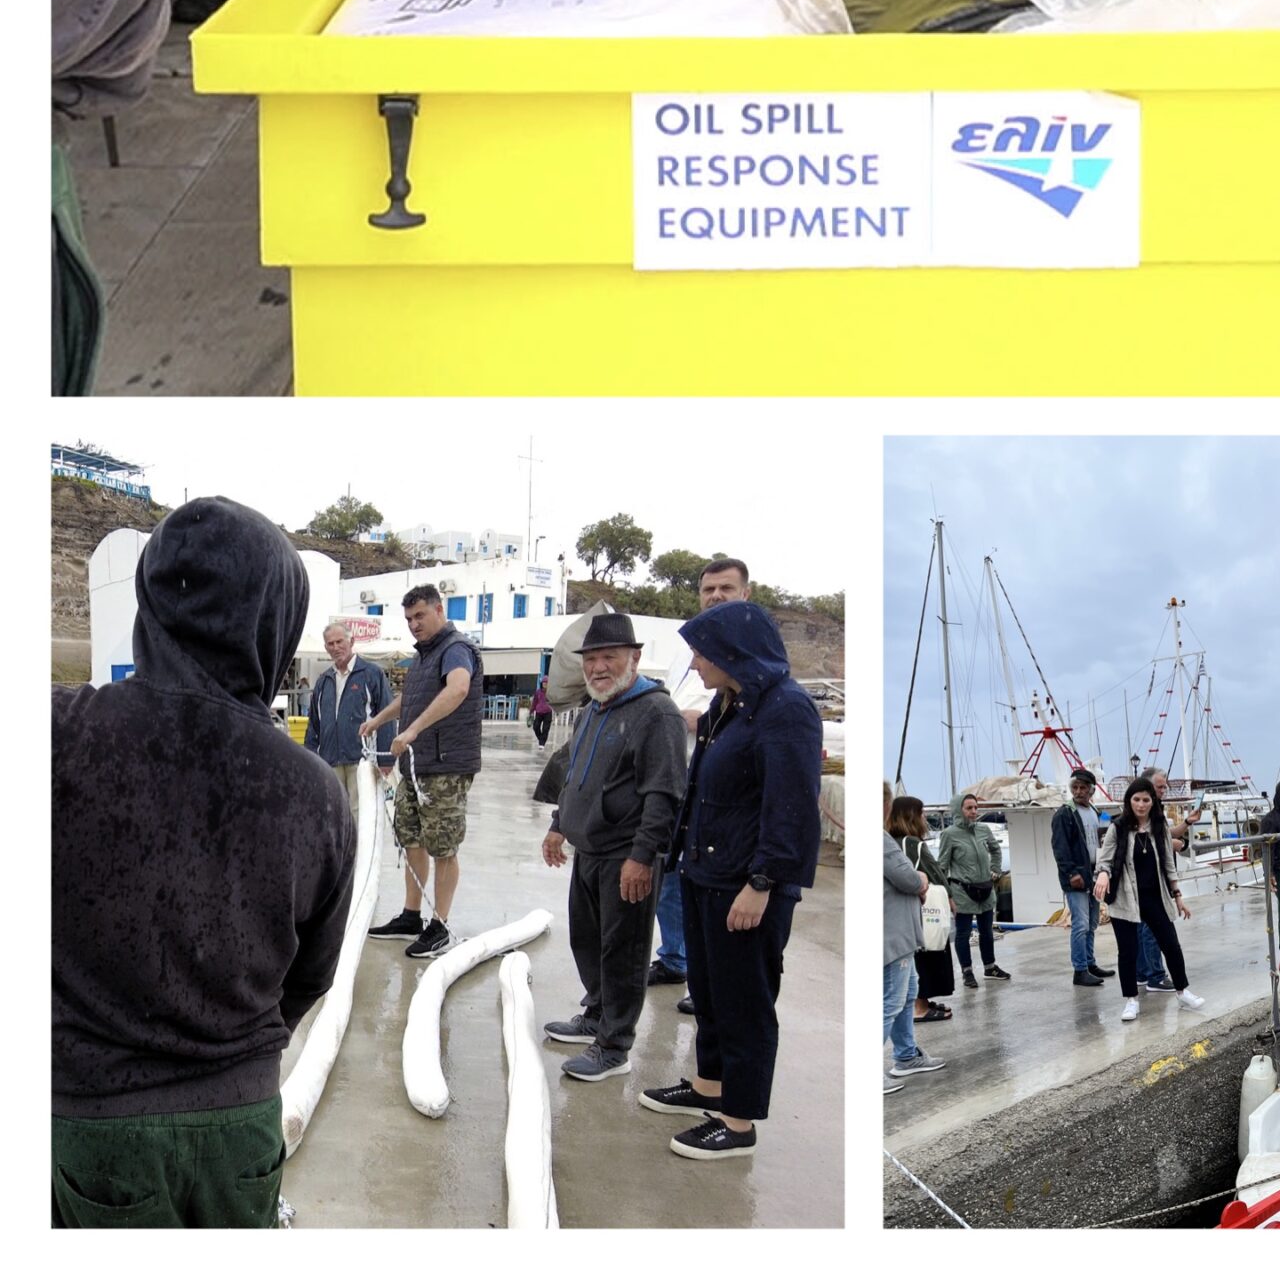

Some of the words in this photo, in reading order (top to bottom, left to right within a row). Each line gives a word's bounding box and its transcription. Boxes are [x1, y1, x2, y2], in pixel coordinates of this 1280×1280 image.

[655, 103, 724, 135] OIL
[741, 103, 844, 135] SPILL
[657, 154, 879, 187] RESPONSE
[659, 207, 910, 240] EQUIPMENT
[351, 622, 379, 637] Market
